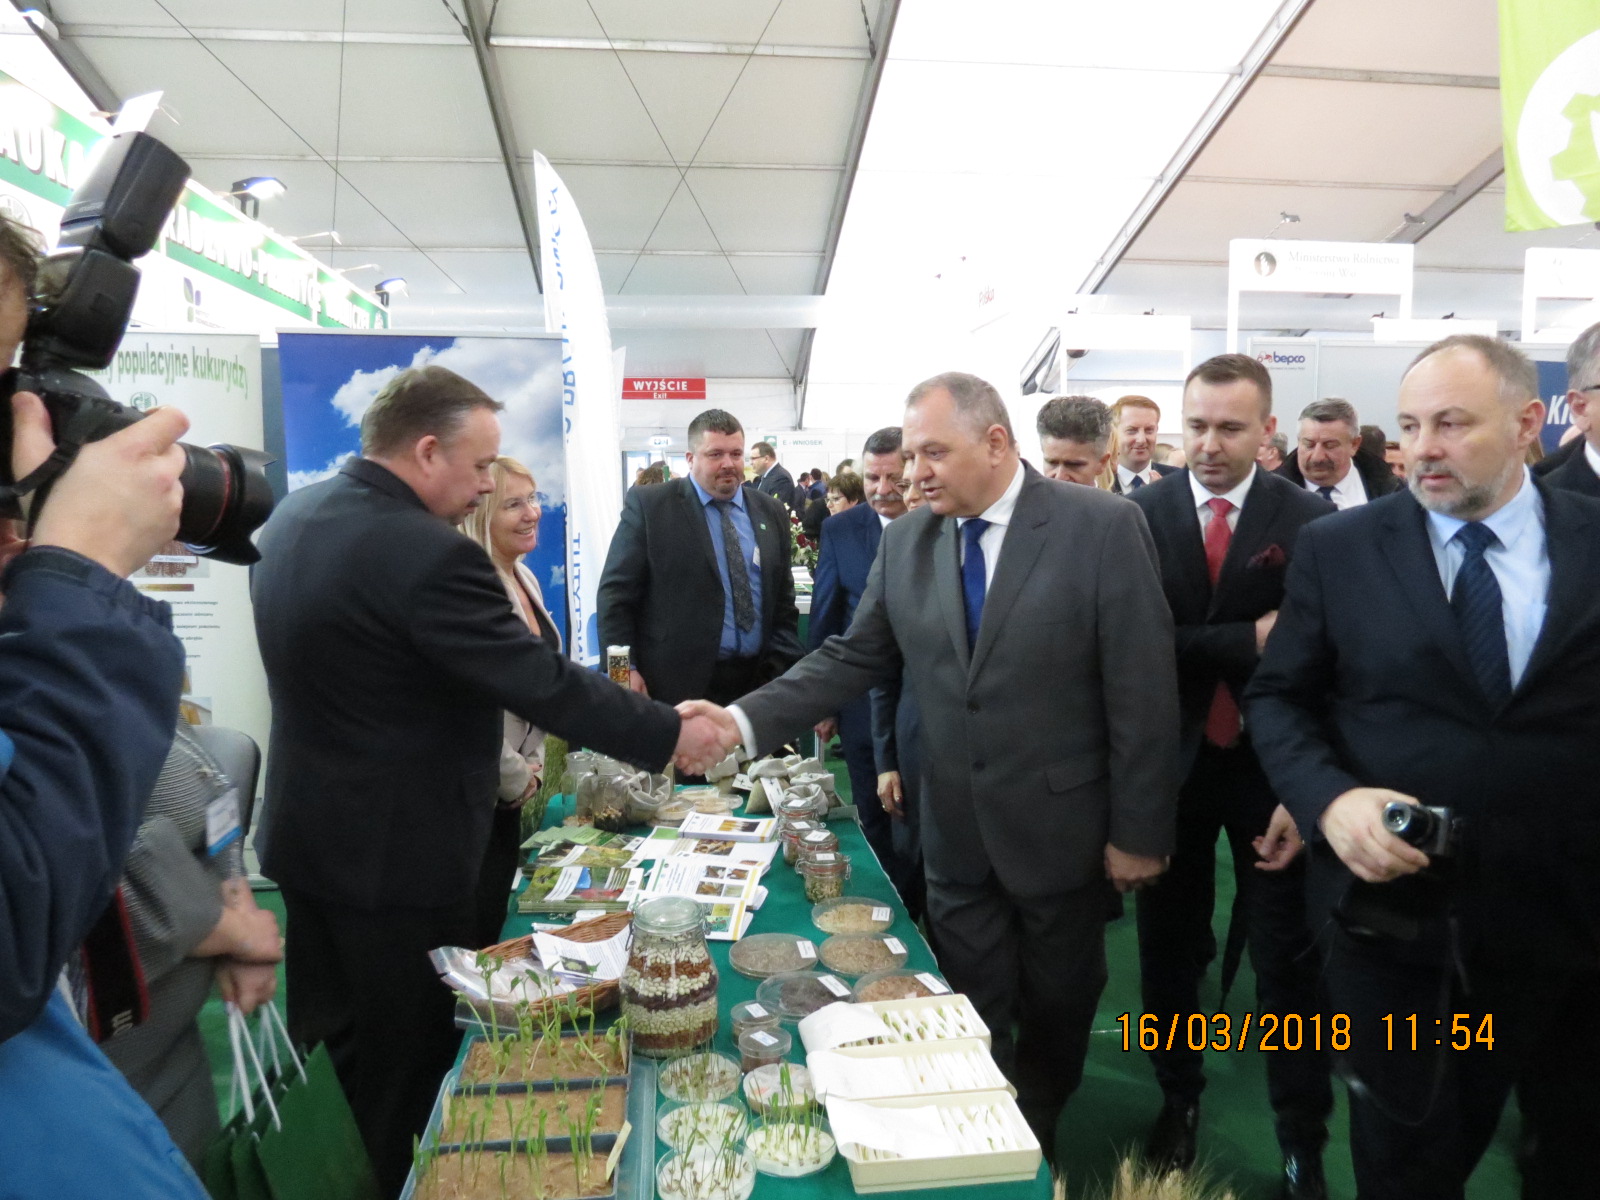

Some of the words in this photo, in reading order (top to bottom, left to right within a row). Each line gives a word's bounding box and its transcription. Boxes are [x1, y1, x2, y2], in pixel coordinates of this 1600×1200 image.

[1353, 252, 1400, 265] Rolnictwa
[118, 342, 189, 385] populacyjne
[1273, 351, 1305, 365] bepco
[633, 379, 688, 391] WYJŚCIE
